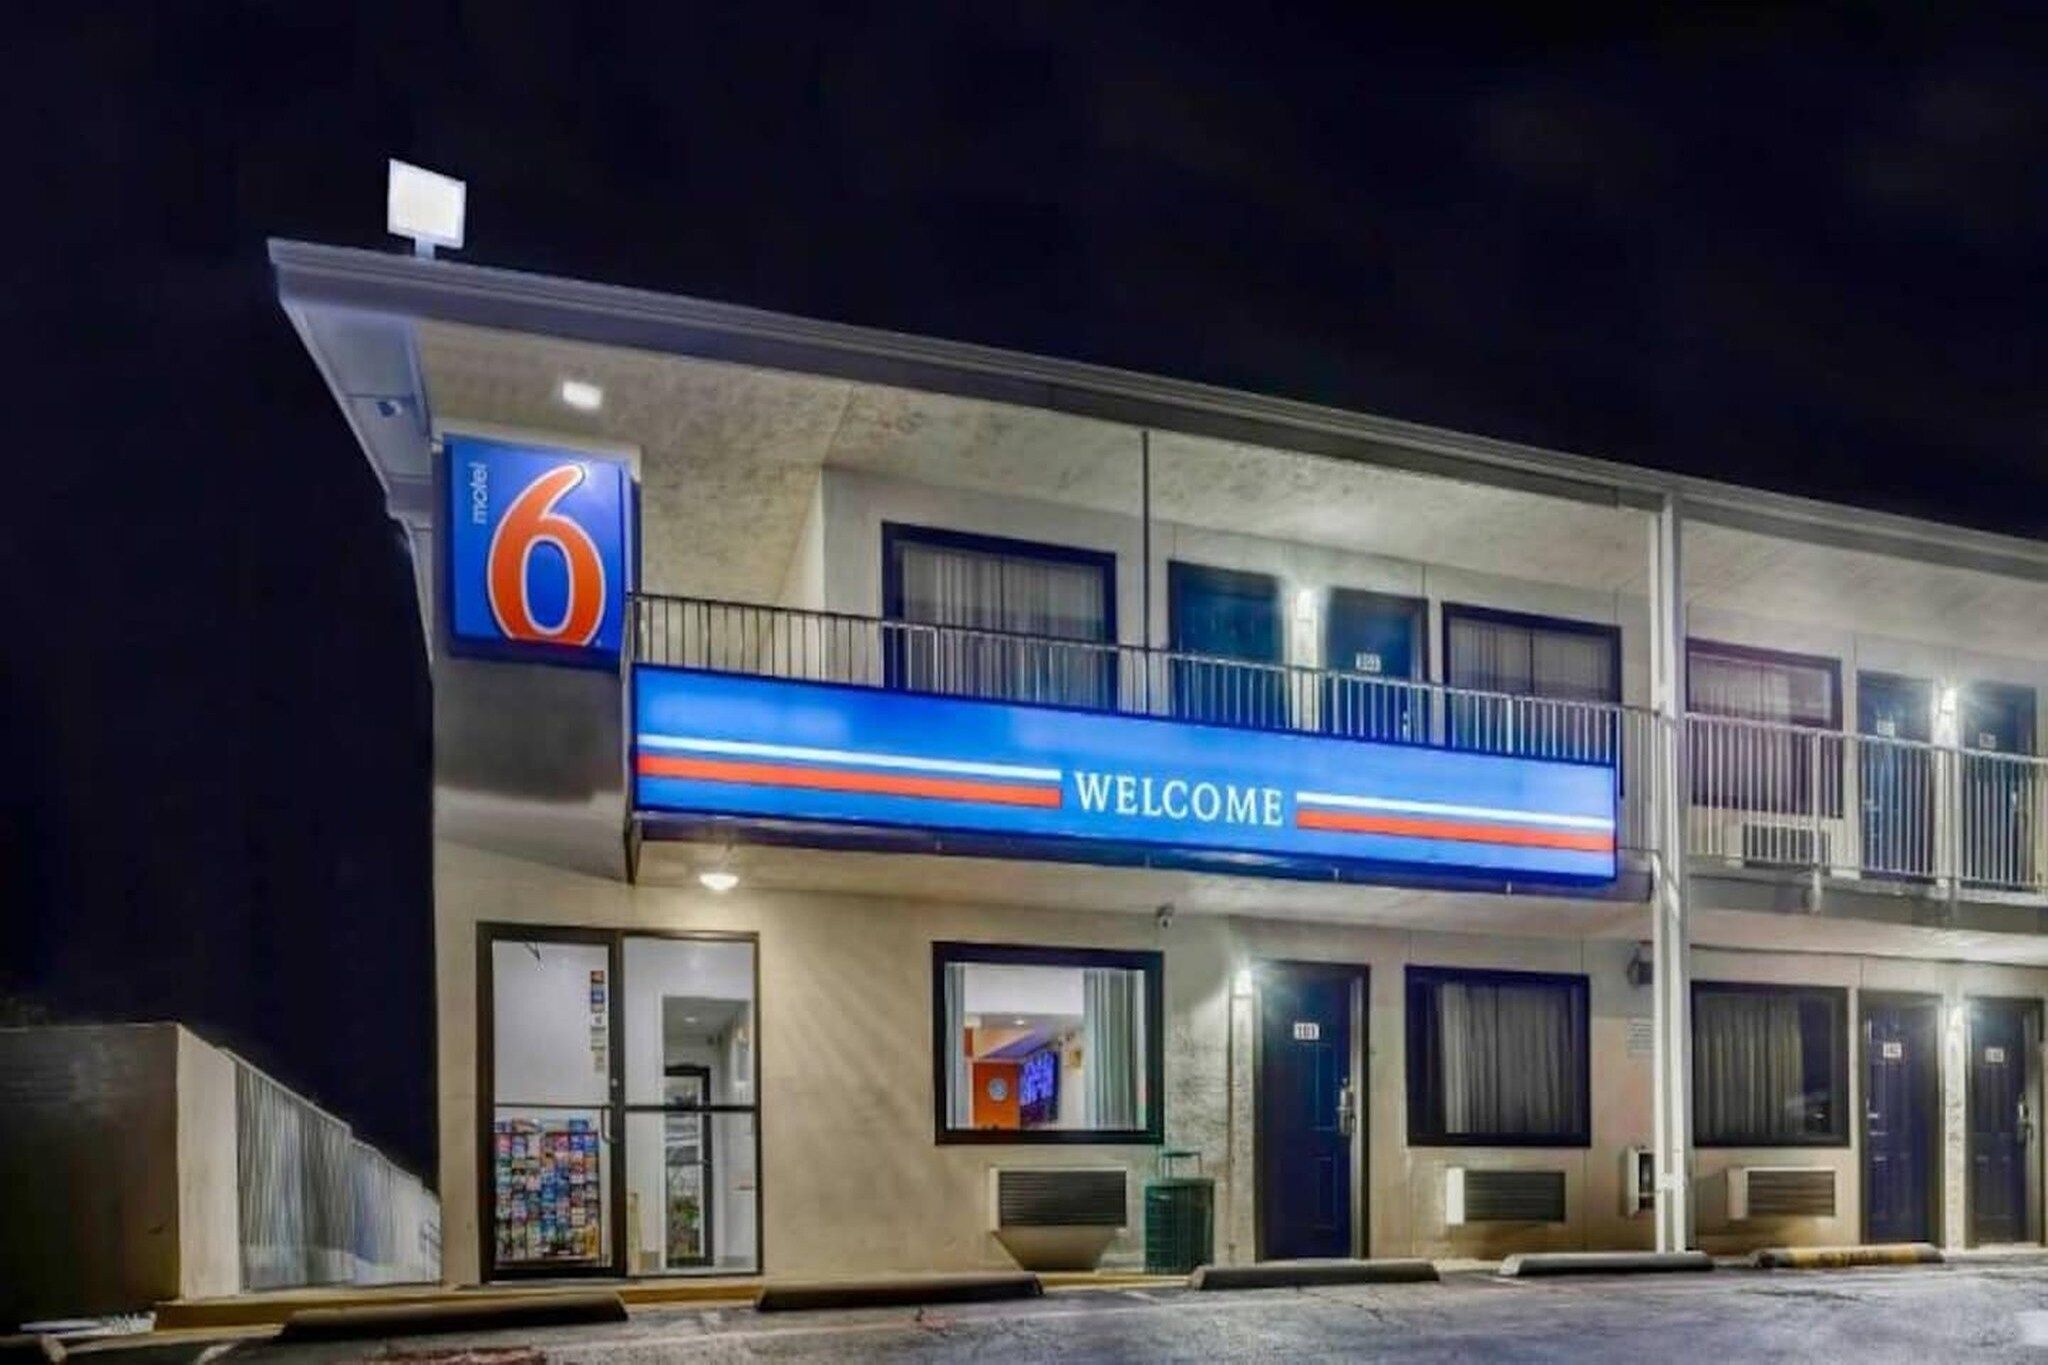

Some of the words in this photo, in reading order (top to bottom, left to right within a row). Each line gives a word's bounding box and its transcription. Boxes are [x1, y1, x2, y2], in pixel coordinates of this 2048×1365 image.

[468, 462, 488, 525] motel
[486, 463, 606, 647] 6
[1073, 768, 1285, 827] WELCOME
